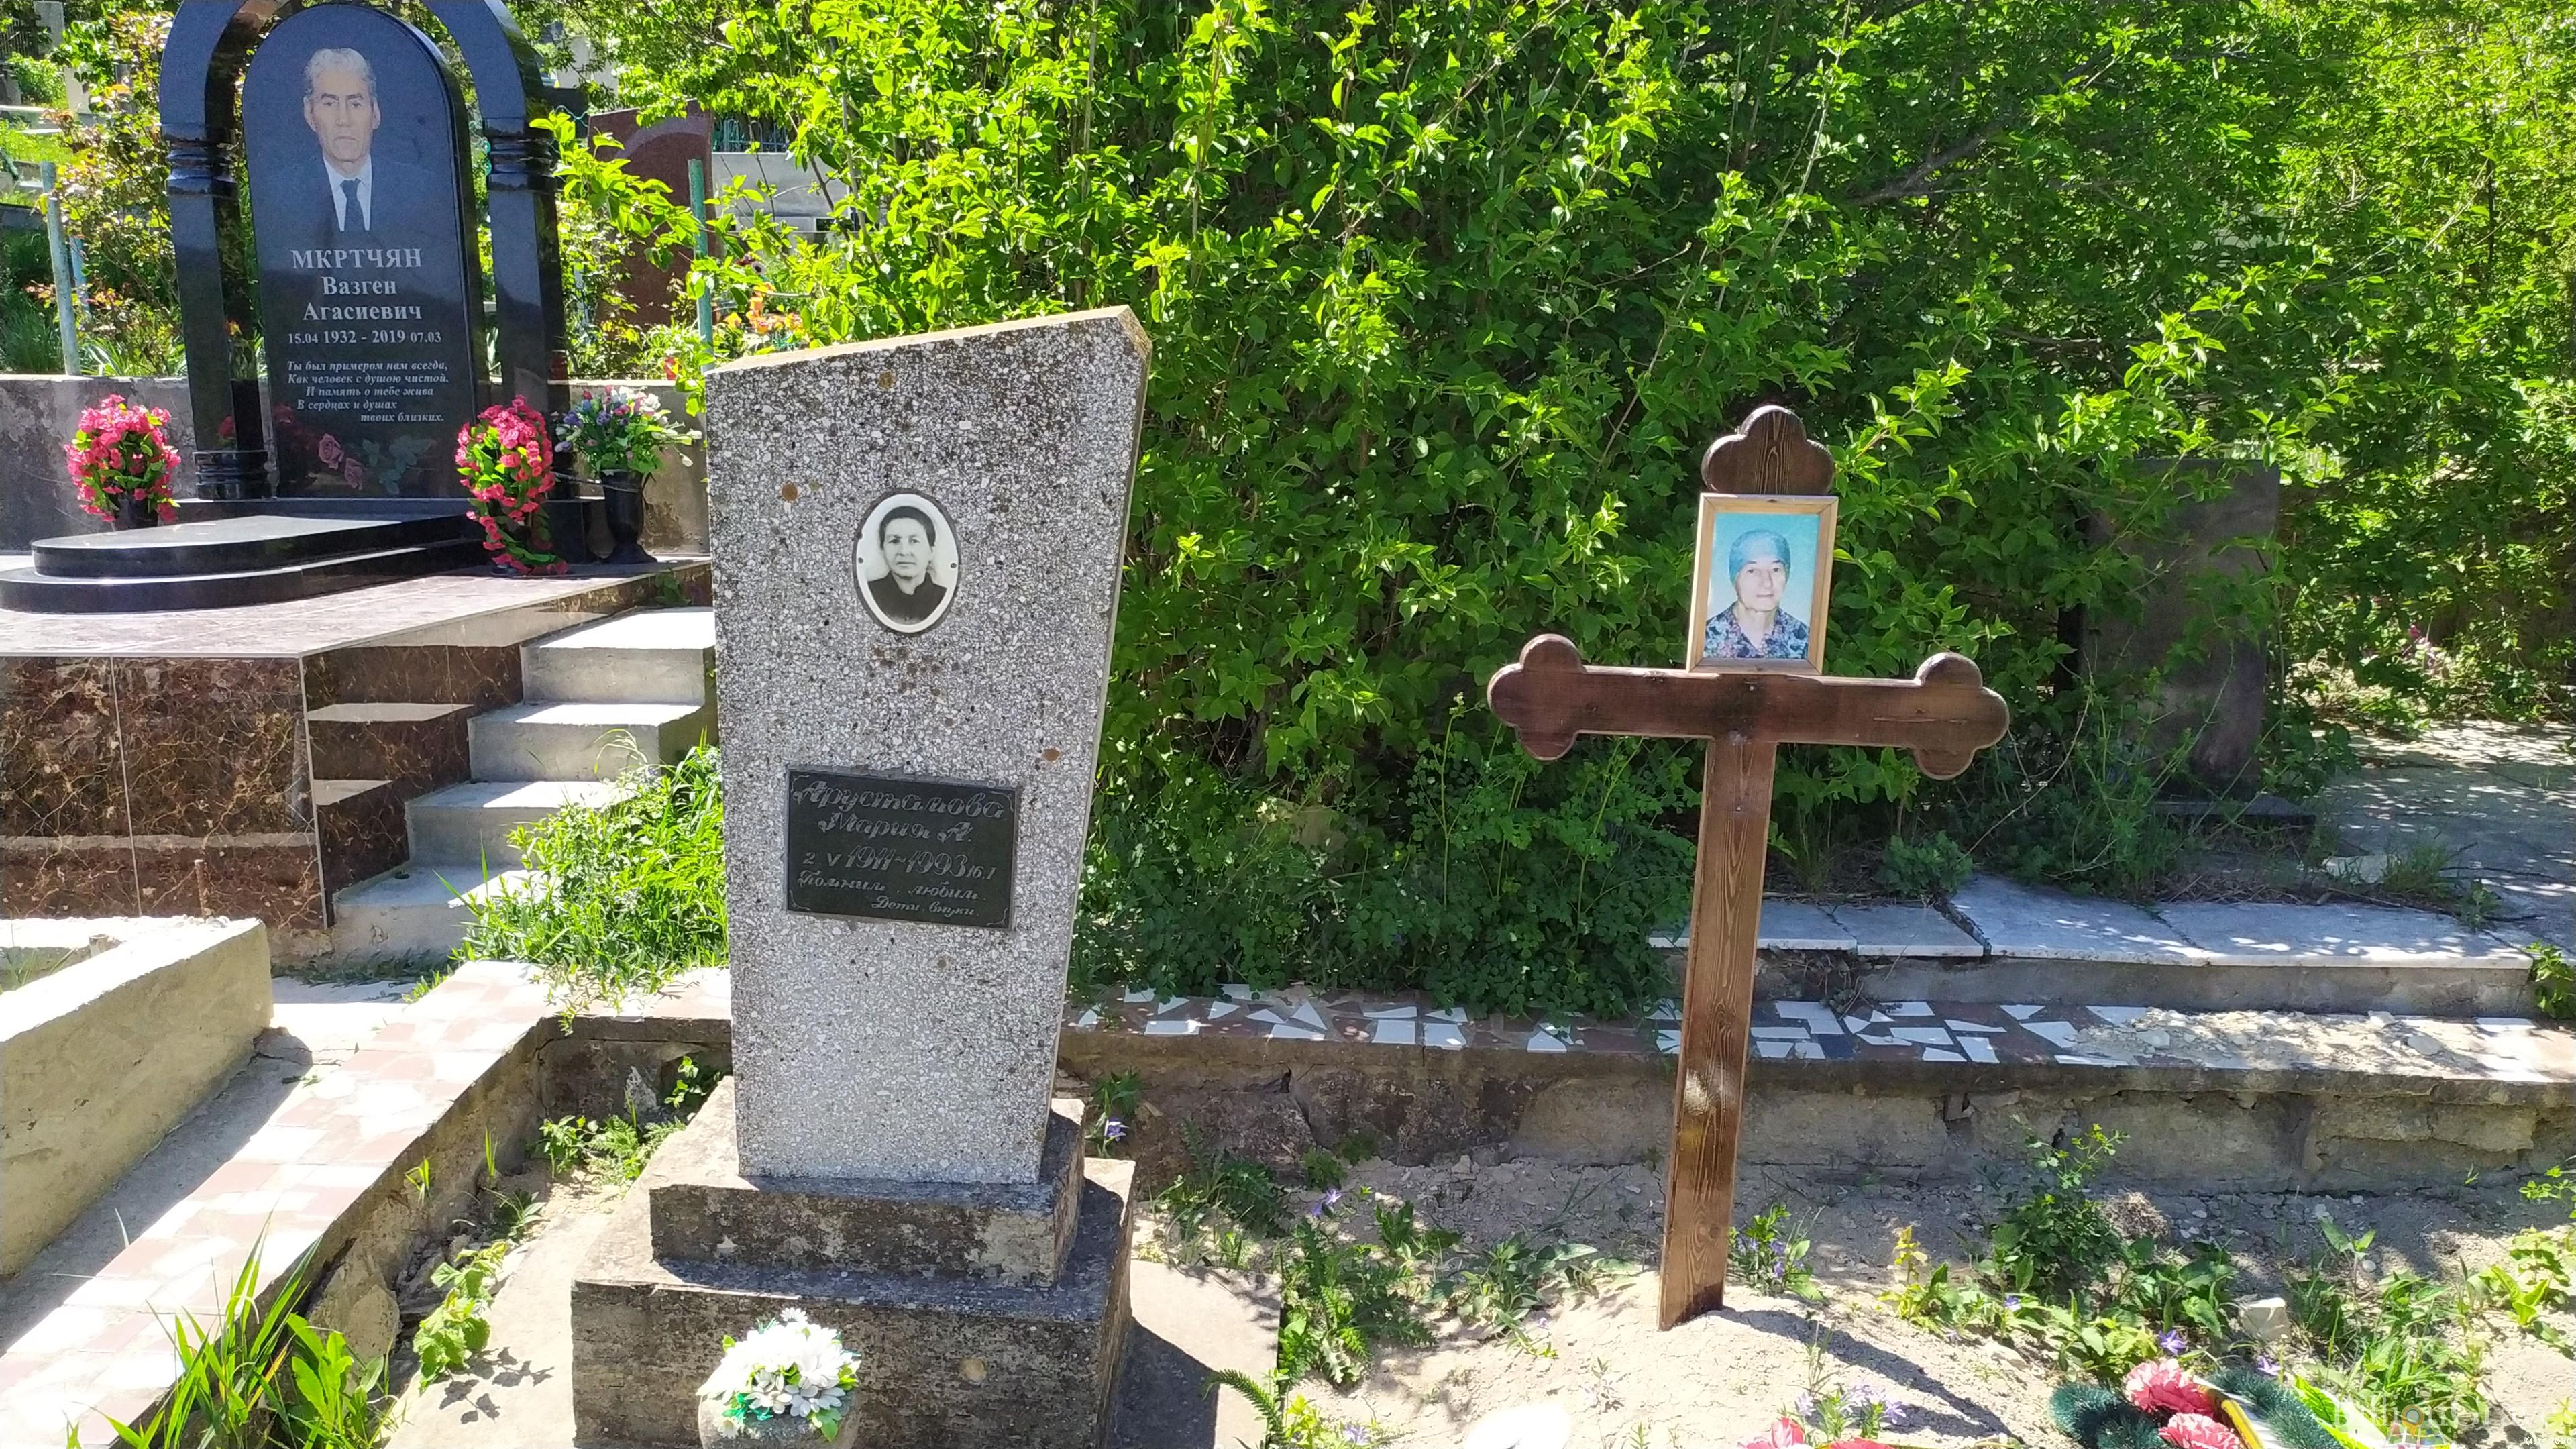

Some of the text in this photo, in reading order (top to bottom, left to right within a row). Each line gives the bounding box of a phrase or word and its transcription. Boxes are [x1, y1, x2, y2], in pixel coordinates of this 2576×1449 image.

[290, 248, 422, 268] МКРТЧЯН
[321, 276, 397, 295] Вазген
[303, 302, 422, 321] Агасиевич
[288, 333, 319, 344] 15.04
[323, 330, 357, 343] 1932
[372, 329, 406, 343] 2019
[410, 331, 441, 343] 07.03
[287, 360, 448, 373] Ты был примером нам всегда,
[288, 374, 309, 384] Как
[312, 376, 353, 384] человек
[364, 372, 402, 386] душою
[405, 373, 449, 383] чистой.
[306, 386, 315, 396] И
[318, 388, 362, 396] память
[374, 386, 400, 396] тебе
[297, 399, 305, 409] В
[308, 398, 350, 412] сердцах
[363, 398, 398, 412] душах
[360, 412, 444, 422] твоих близких.
[818, 812, 931, 839] Мария
[802, 852, 816, 865] 2
